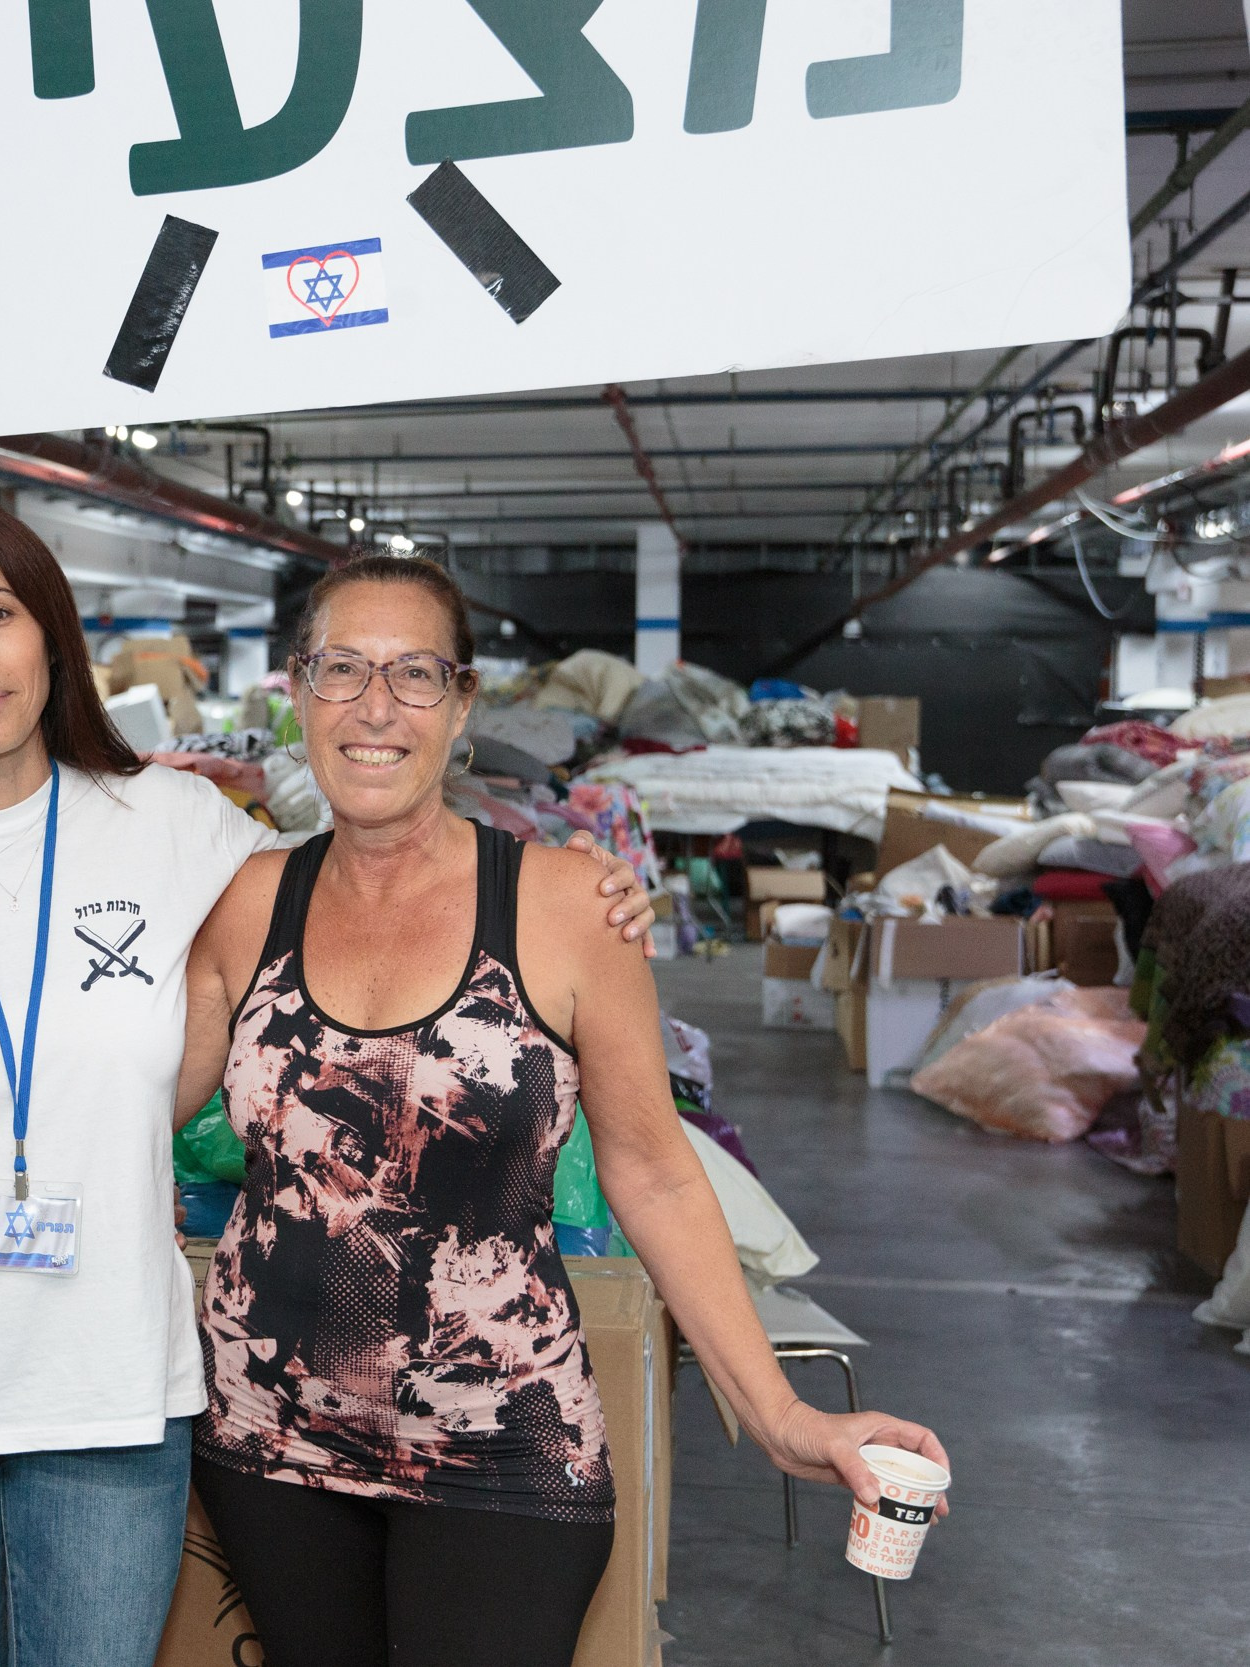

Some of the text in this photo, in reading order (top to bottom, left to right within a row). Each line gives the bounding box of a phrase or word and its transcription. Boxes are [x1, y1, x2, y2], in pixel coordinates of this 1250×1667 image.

[74, 899, 141, 920] חרבות ברזל
[36, 1221, 75, 1234] תמרה
[884, 1484, 940, 1505] OFF
[895, 1507, 925, 1522] TEA
[866, 1563, 894, 1576] MOVE
